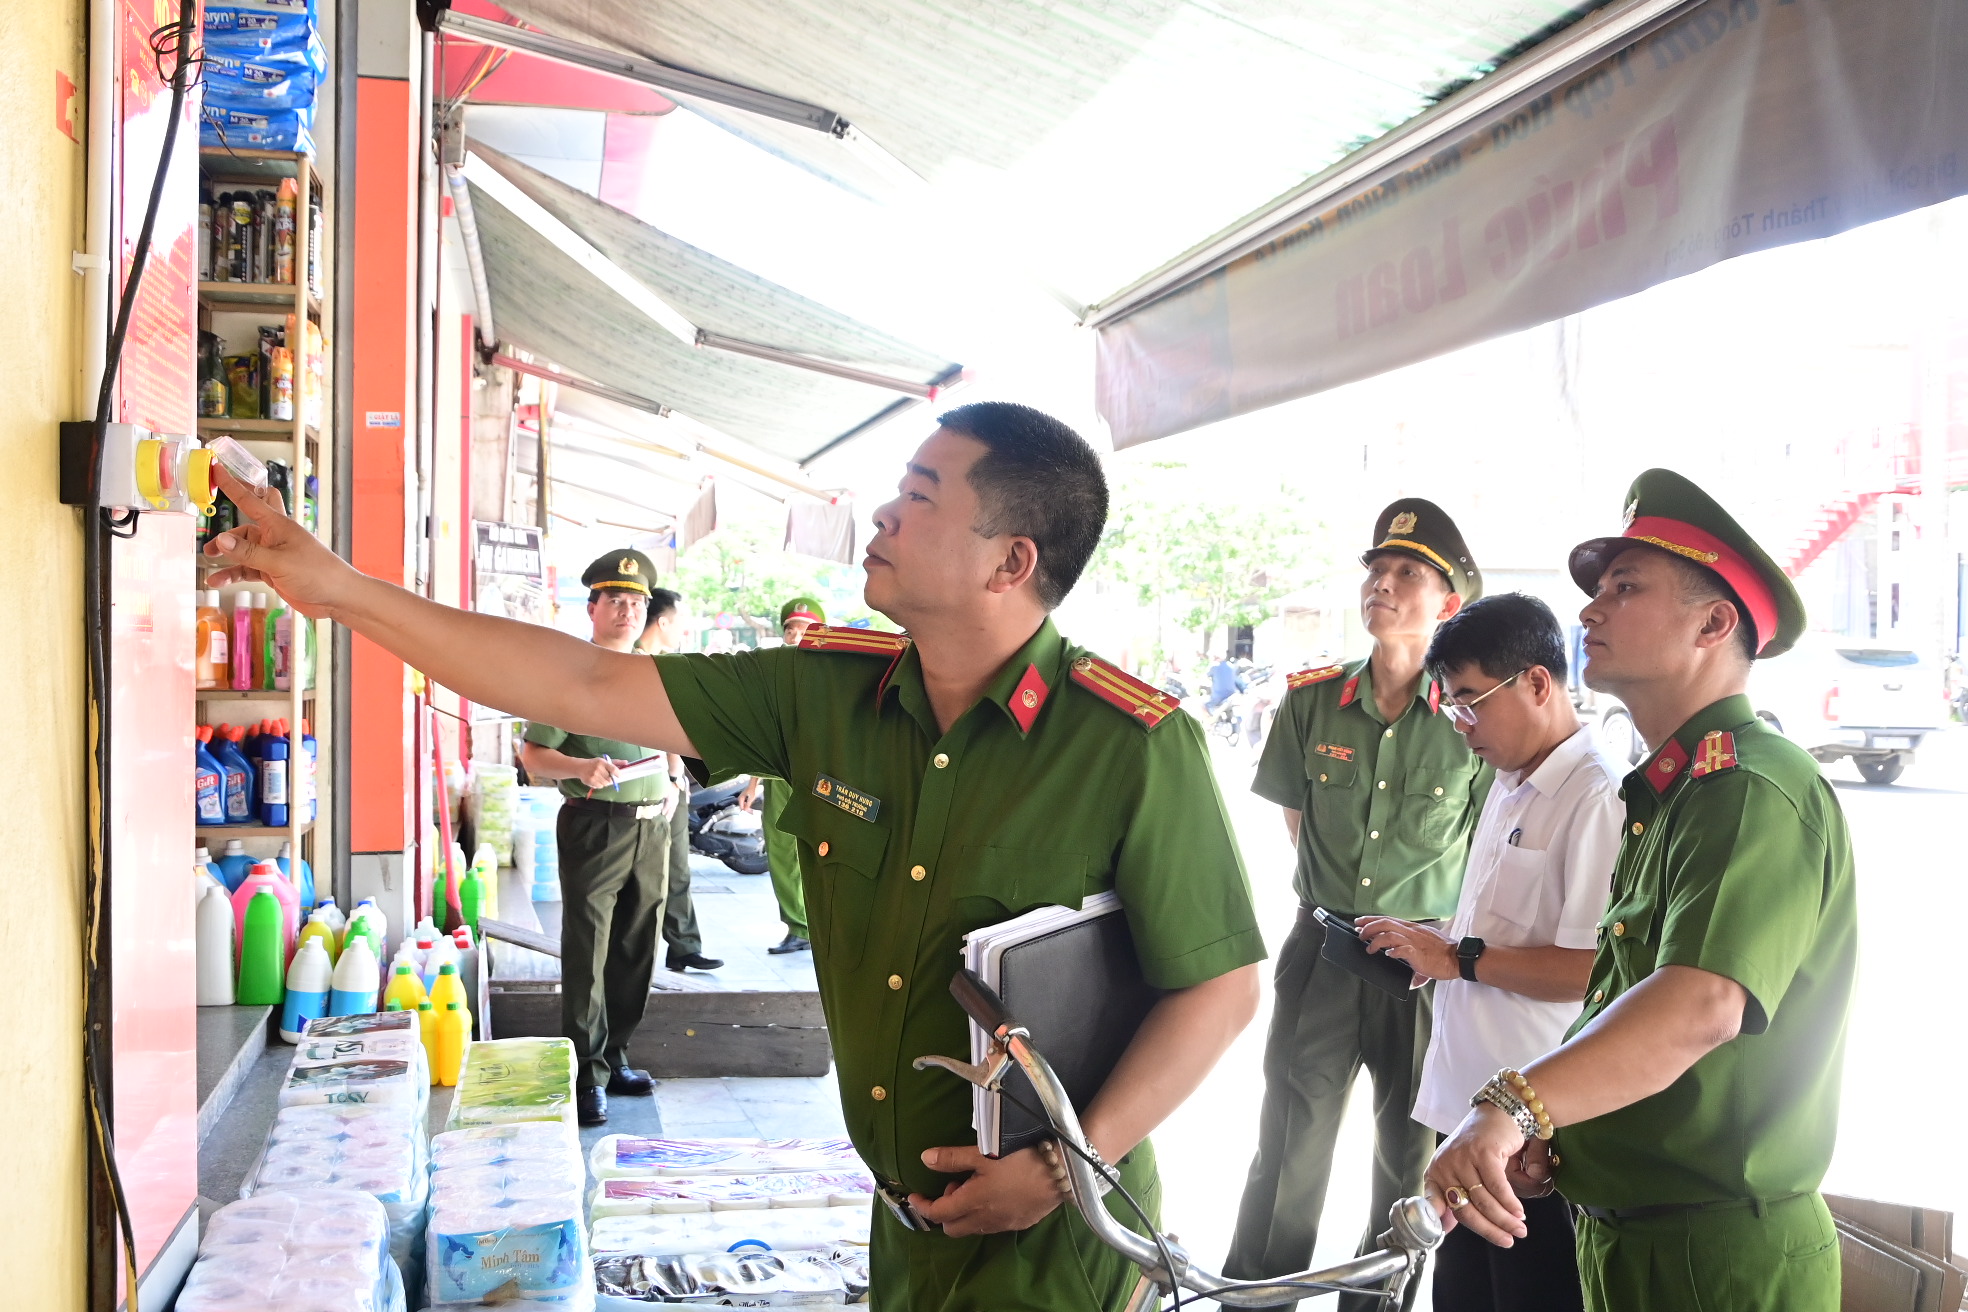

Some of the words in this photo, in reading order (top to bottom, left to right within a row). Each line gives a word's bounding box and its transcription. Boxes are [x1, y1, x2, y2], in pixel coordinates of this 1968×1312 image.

[197, 775, 215, 788] Gift
[324, 1091, 369, 1104] TOSY
[481, 1253, 509, 1270] Minh
[513, 1248, 540, 1264] Tâm
